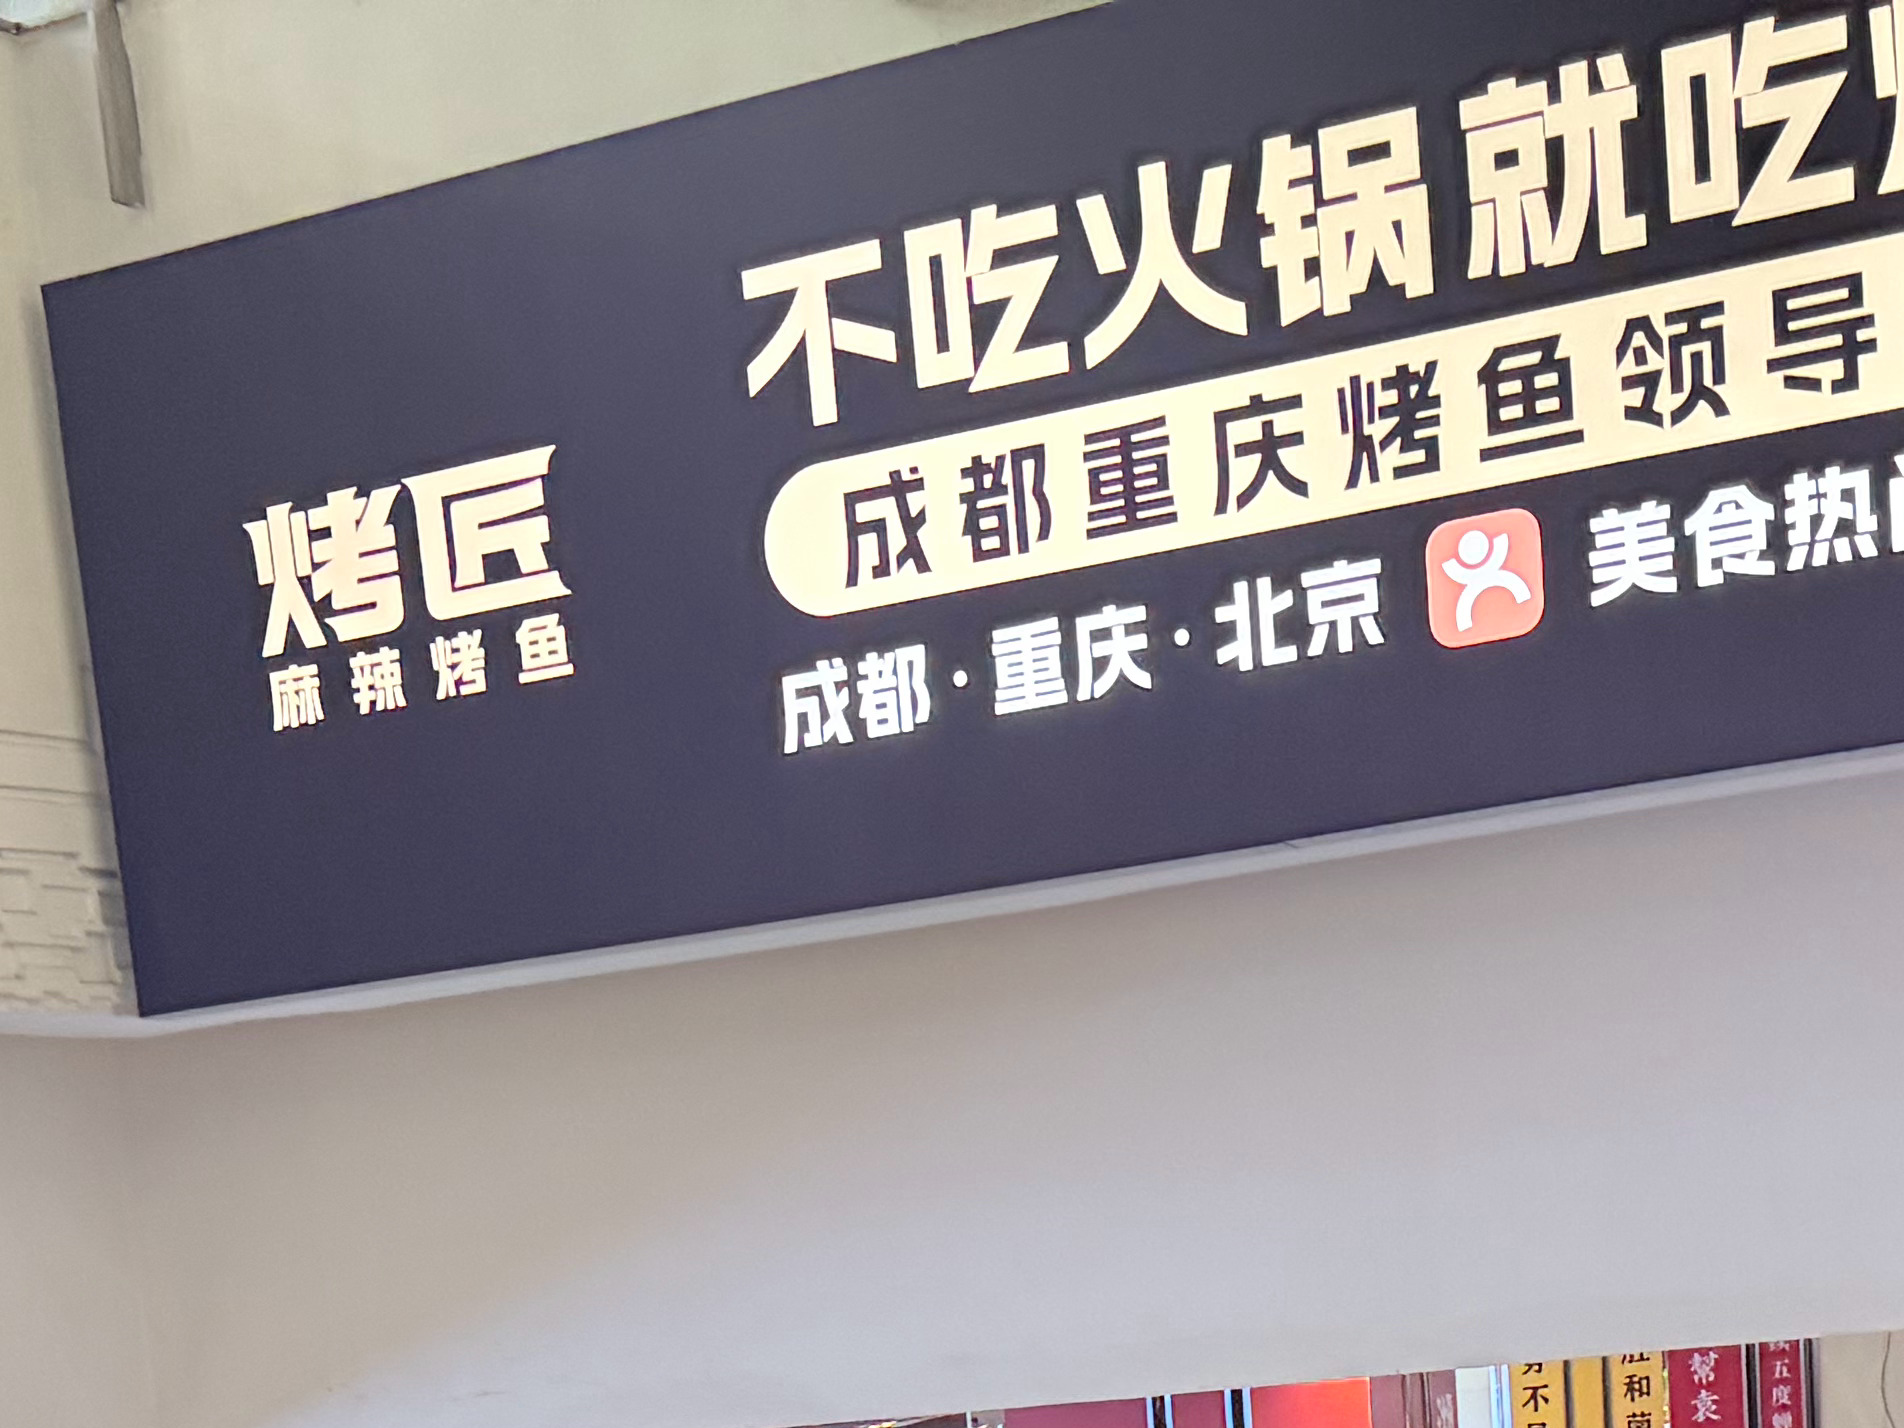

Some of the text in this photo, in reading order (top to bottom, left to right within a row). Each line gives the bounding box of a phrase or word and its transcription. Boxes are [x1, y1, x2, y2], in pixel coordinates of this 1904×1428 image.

[242, 444, 572, 658] 烤匠
[266, 612, 576, 733] 麻辣烤鱼
[780, 556, 1388, 755] 成都·重庆·北京
